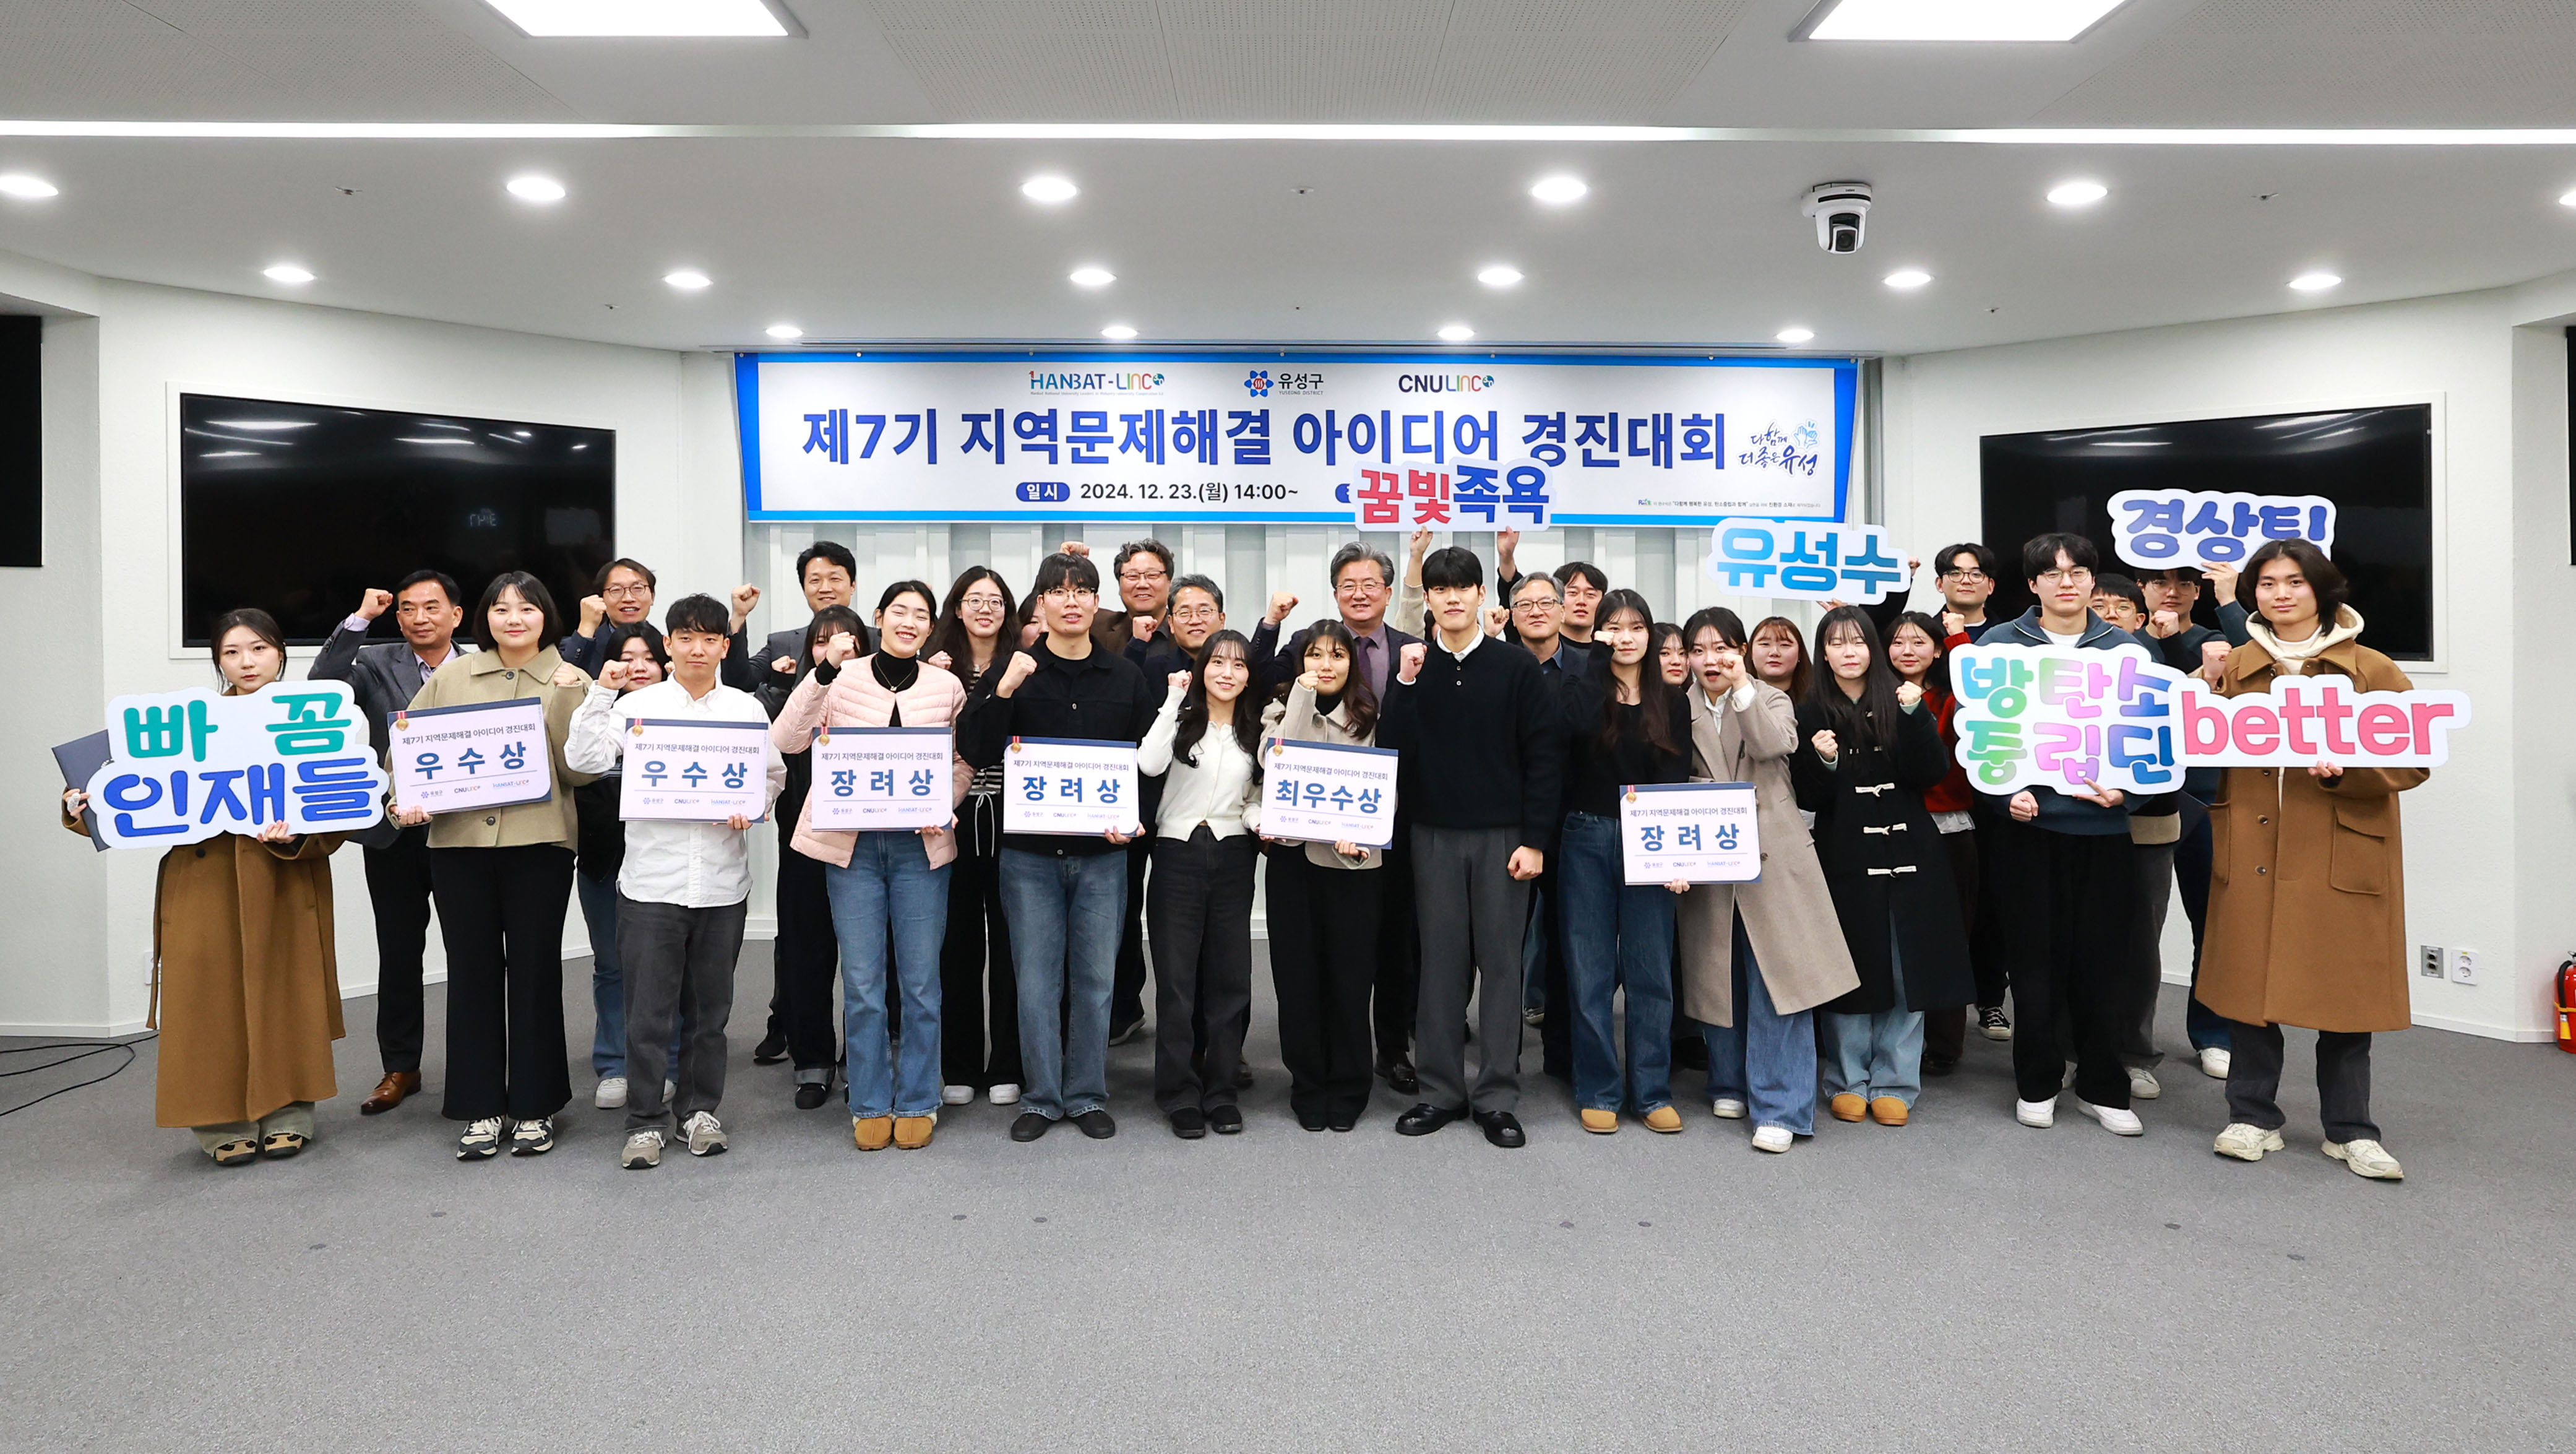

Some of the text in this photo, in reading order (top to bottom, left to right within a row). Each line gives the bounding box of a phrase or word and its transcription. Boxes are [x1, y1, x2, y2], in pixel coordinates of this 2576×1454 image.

[1278, 373, 1324, 390] 유성구
[803, 408, 1725, 469] 제7기 지역문제해결 아이디어 경진대회
[1025, 483, 1059, 500] 일시
[1080, 483, 1133, 499] 2024.
[1139, 484, 1163, 499] 12.
[1234, 484, 1298, 500] 14:00~
[1357, 464, 1550, 525] 꿈빛족욕
[1717, 528, 1901, 594] 유성수
[1960, 657, 2172, 718] 방탄소
[2181, 687, 2455, 755] better
[103, 758, 379, 838] 인재들
[1275, 779, 1382, 814] 최우수상
